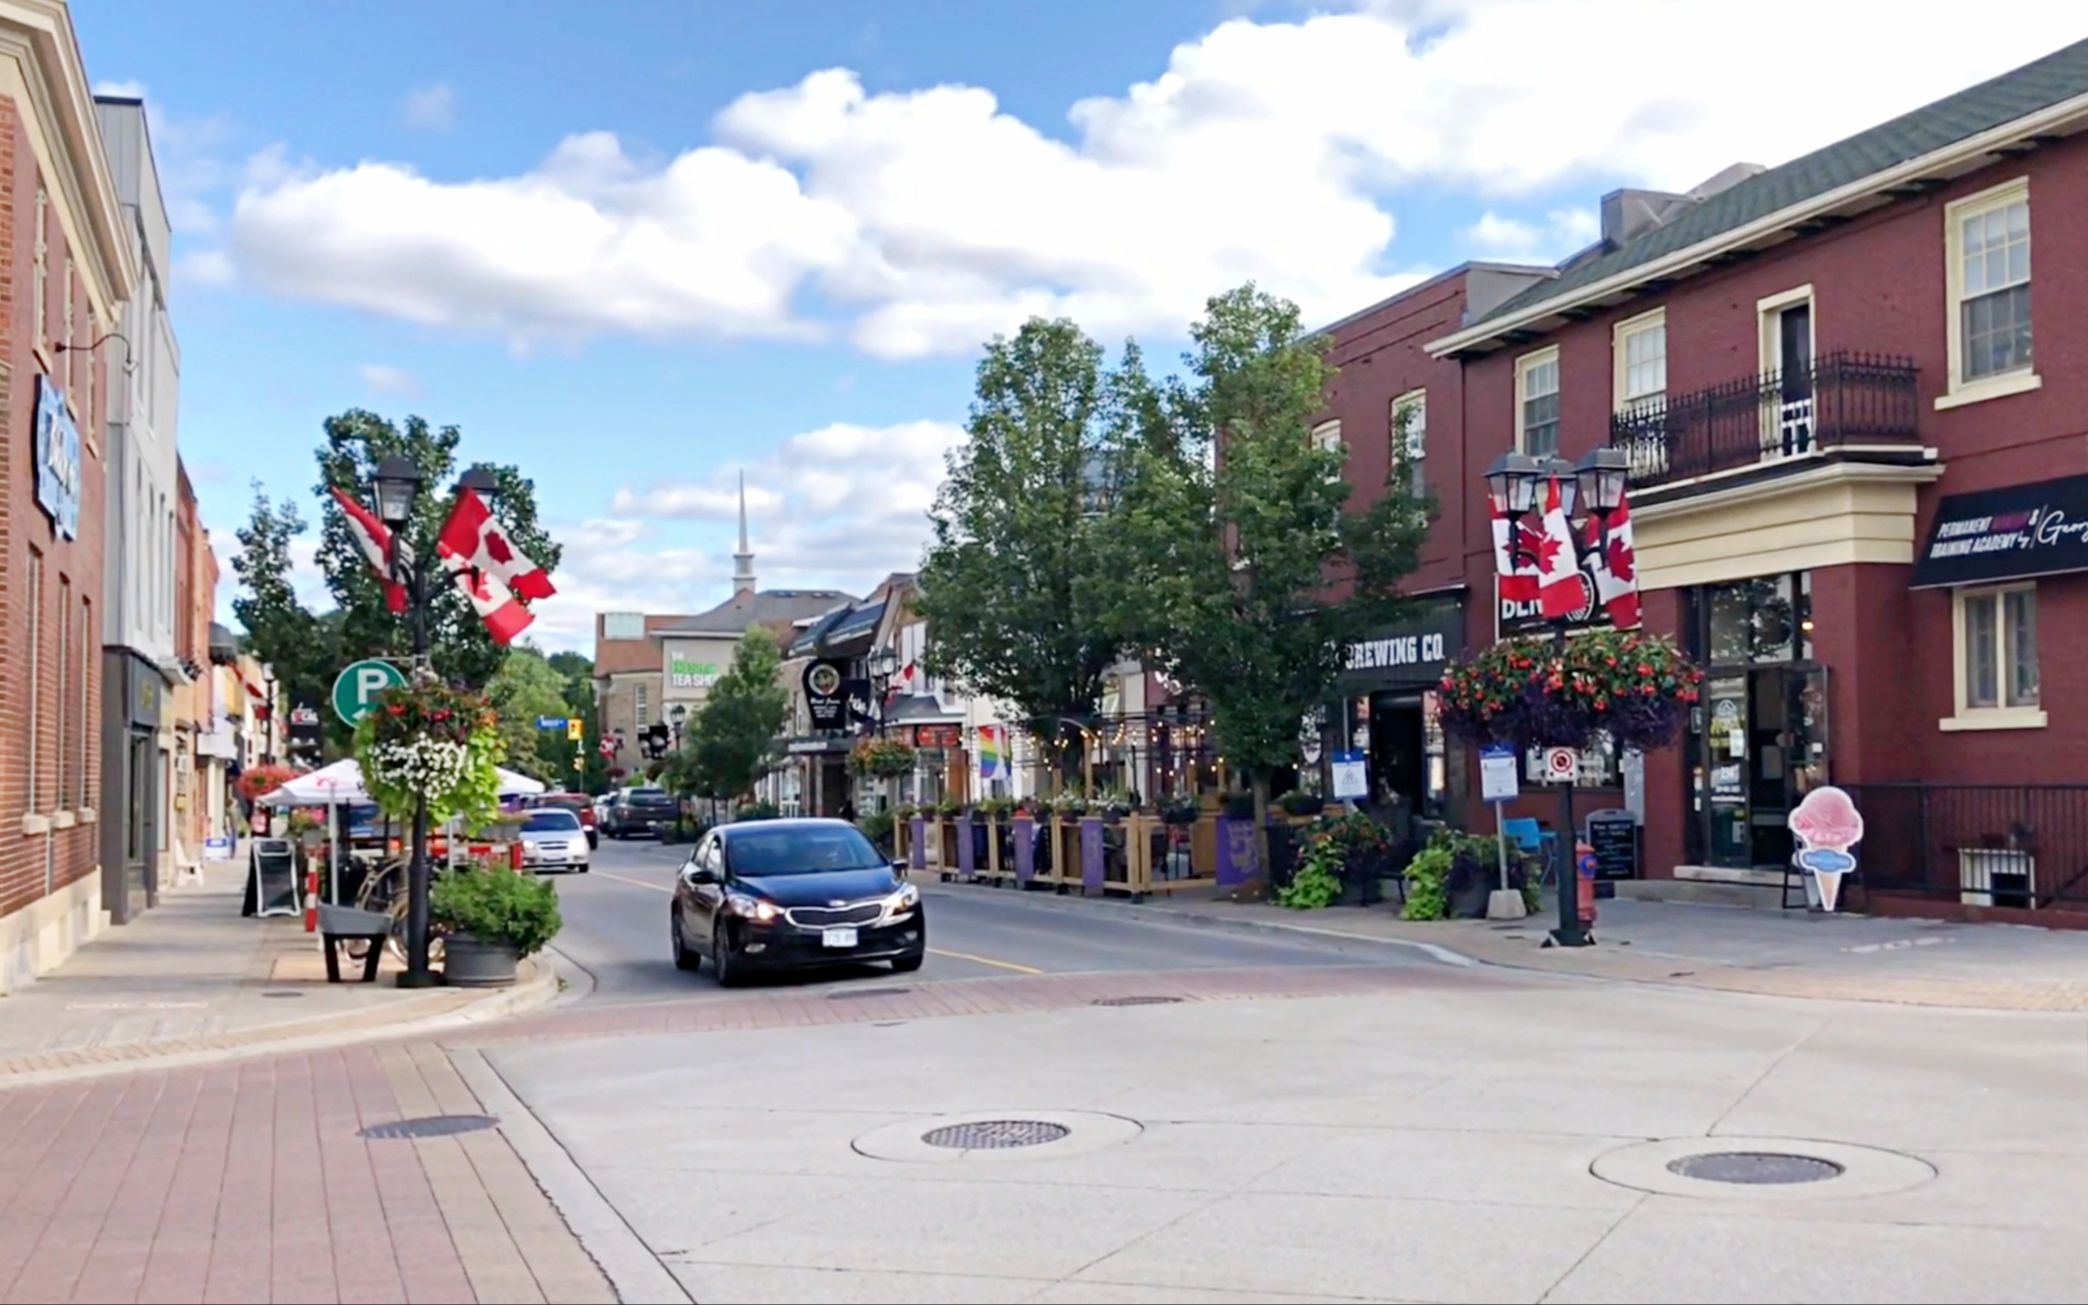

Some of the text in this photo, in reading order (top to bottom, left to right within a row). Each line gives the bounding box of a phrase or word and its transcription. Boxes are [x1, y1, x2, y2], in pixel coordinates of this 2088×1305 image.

[1972, 532, 2017, 552] ACADEMY
[1344, 636, 1418, 670] BREWING
[358, 668, 389, 705] P
[672, 673, 692, 687] TEA
